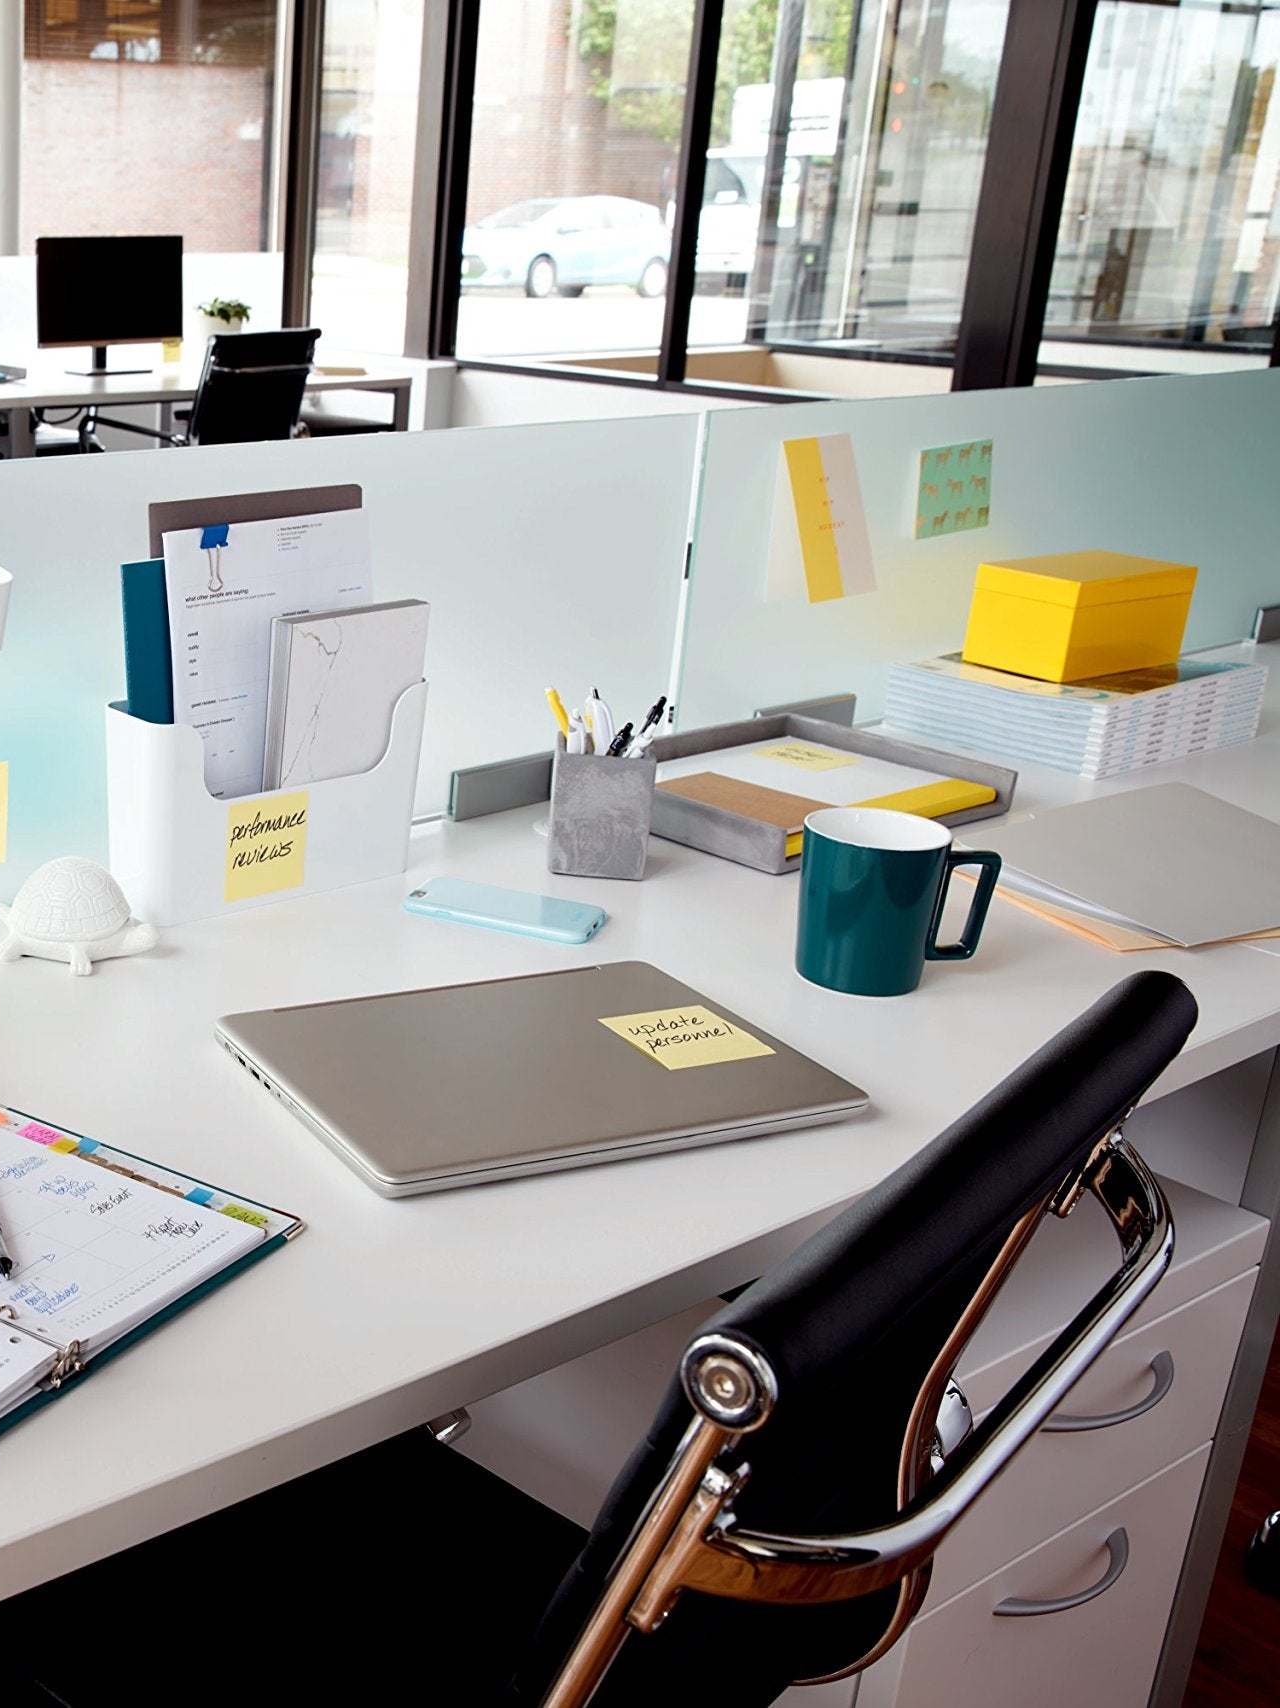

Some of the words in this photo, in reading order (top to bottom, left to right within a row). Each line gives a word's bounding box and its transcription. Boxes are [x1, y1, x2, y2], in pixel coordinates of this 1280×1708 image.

[209, 591, 224, 600] people
[230, 809, 306, 848] performance
[232, 841, 294, 870] reviews
[628, 1015, 705, 1038] update
[646, 1023, 734, 1054] personnel
